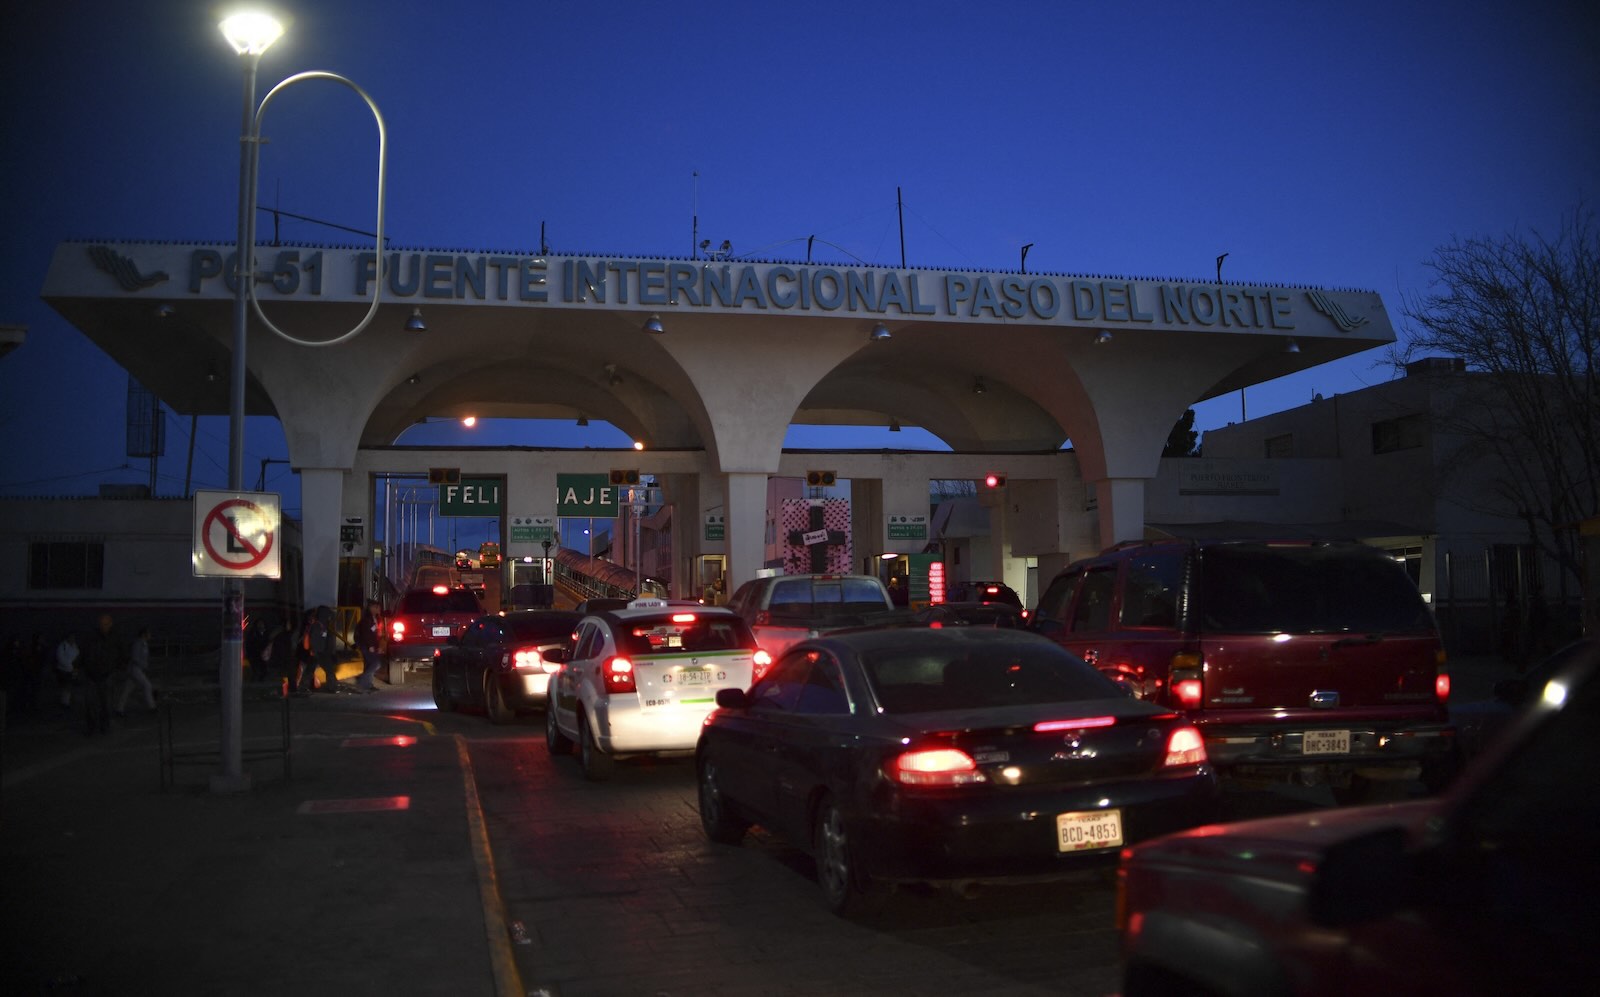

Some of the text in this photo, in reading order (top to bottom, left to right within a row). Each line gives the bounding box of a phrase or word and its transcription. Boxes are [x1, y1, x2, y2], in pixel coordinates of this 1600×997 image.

[356, 252, 548, 301] PUENTE
[563, 259, 936, 315] INTERNACIONAL
[946, 275, 1061, 320] PASO
[1071, 280, 1153, 322] DEL
[1159, 285, 1296, 330] NORTE
[447, 485, 498, 504] FELI
[1062, 823, 1117, 843] BCD-4853
